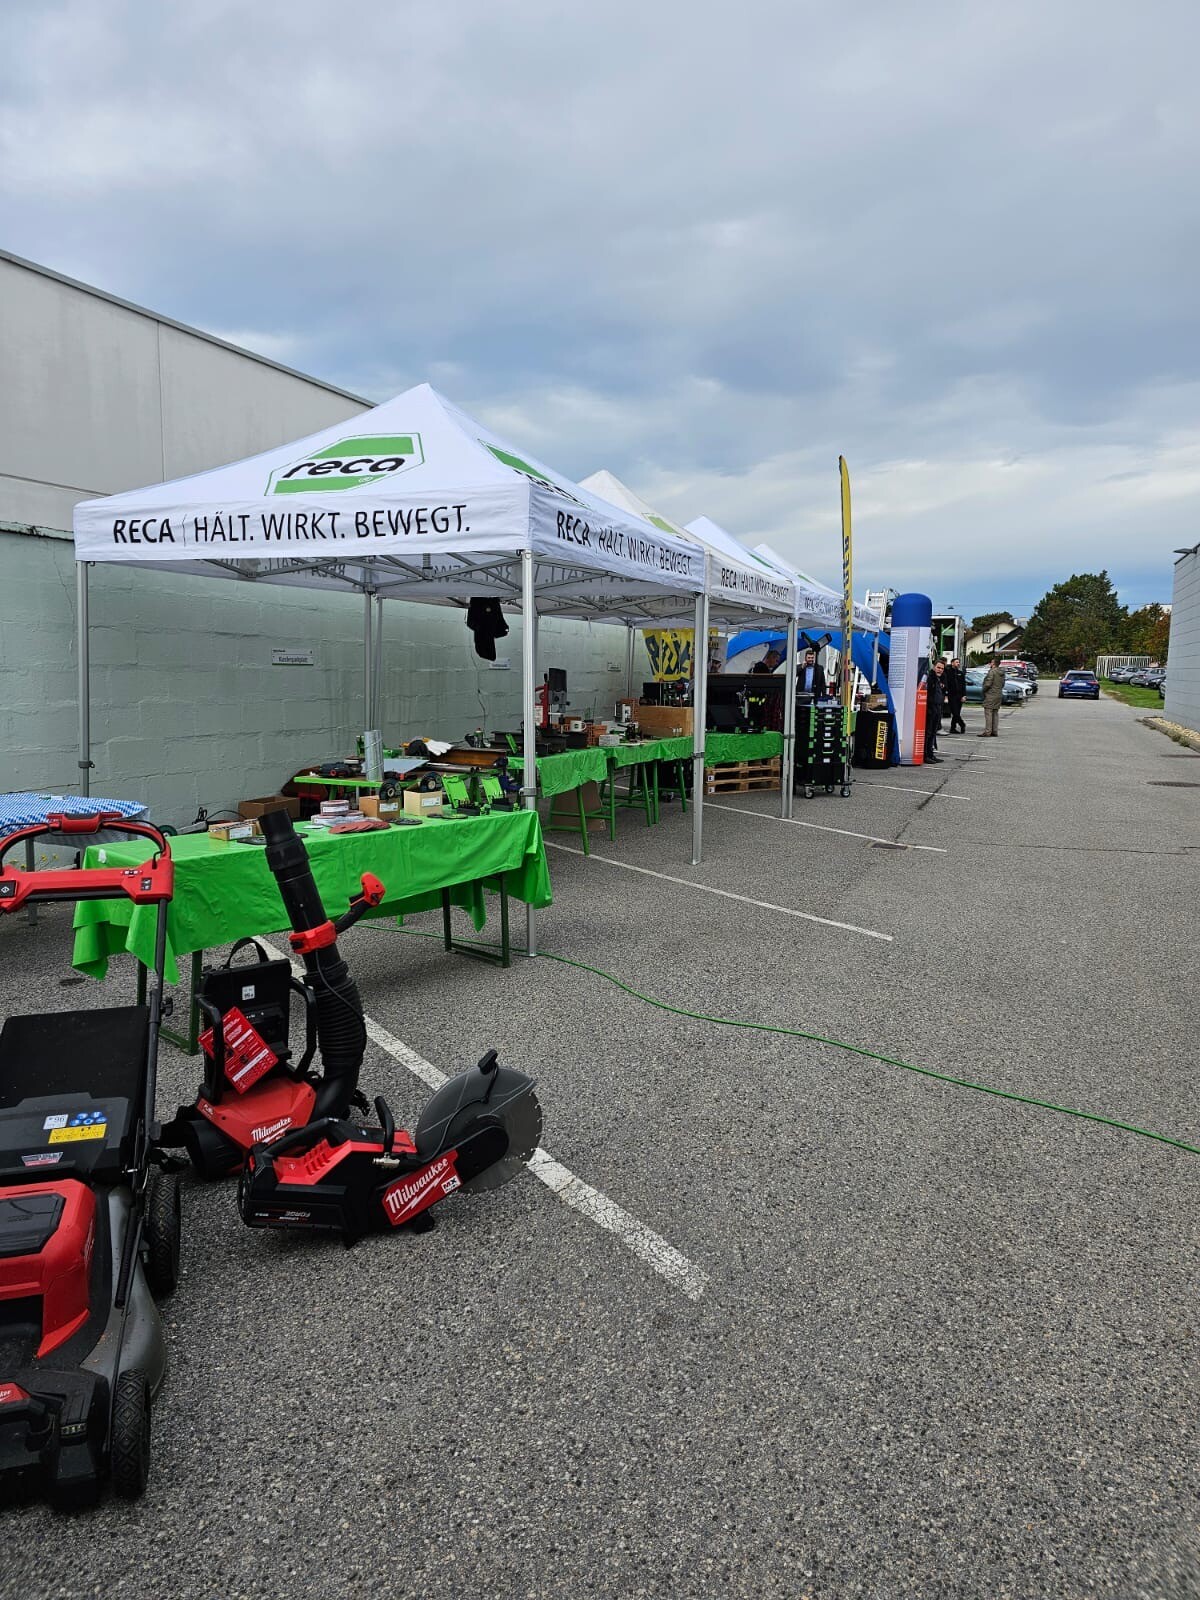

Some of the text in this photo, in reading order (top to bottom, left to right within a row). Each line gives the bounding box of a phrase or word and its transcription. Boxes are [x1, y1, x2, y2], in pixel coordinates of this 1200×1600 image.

[282, 456, 406, 479] reca
[112, 504, 472, 545] RECA HÄLT. WIRKT. BEWEGT.
[556, 510, 693, 577] RECA HÄLT. WIRKT. BEWEGT.
[721, 567, 738, 590] RECA
[251, 1117, 292, 1141] Milwaukee
[386, 1158, 448, 1214] Milwaukee
[443, 1178, 457, 1190] MX
